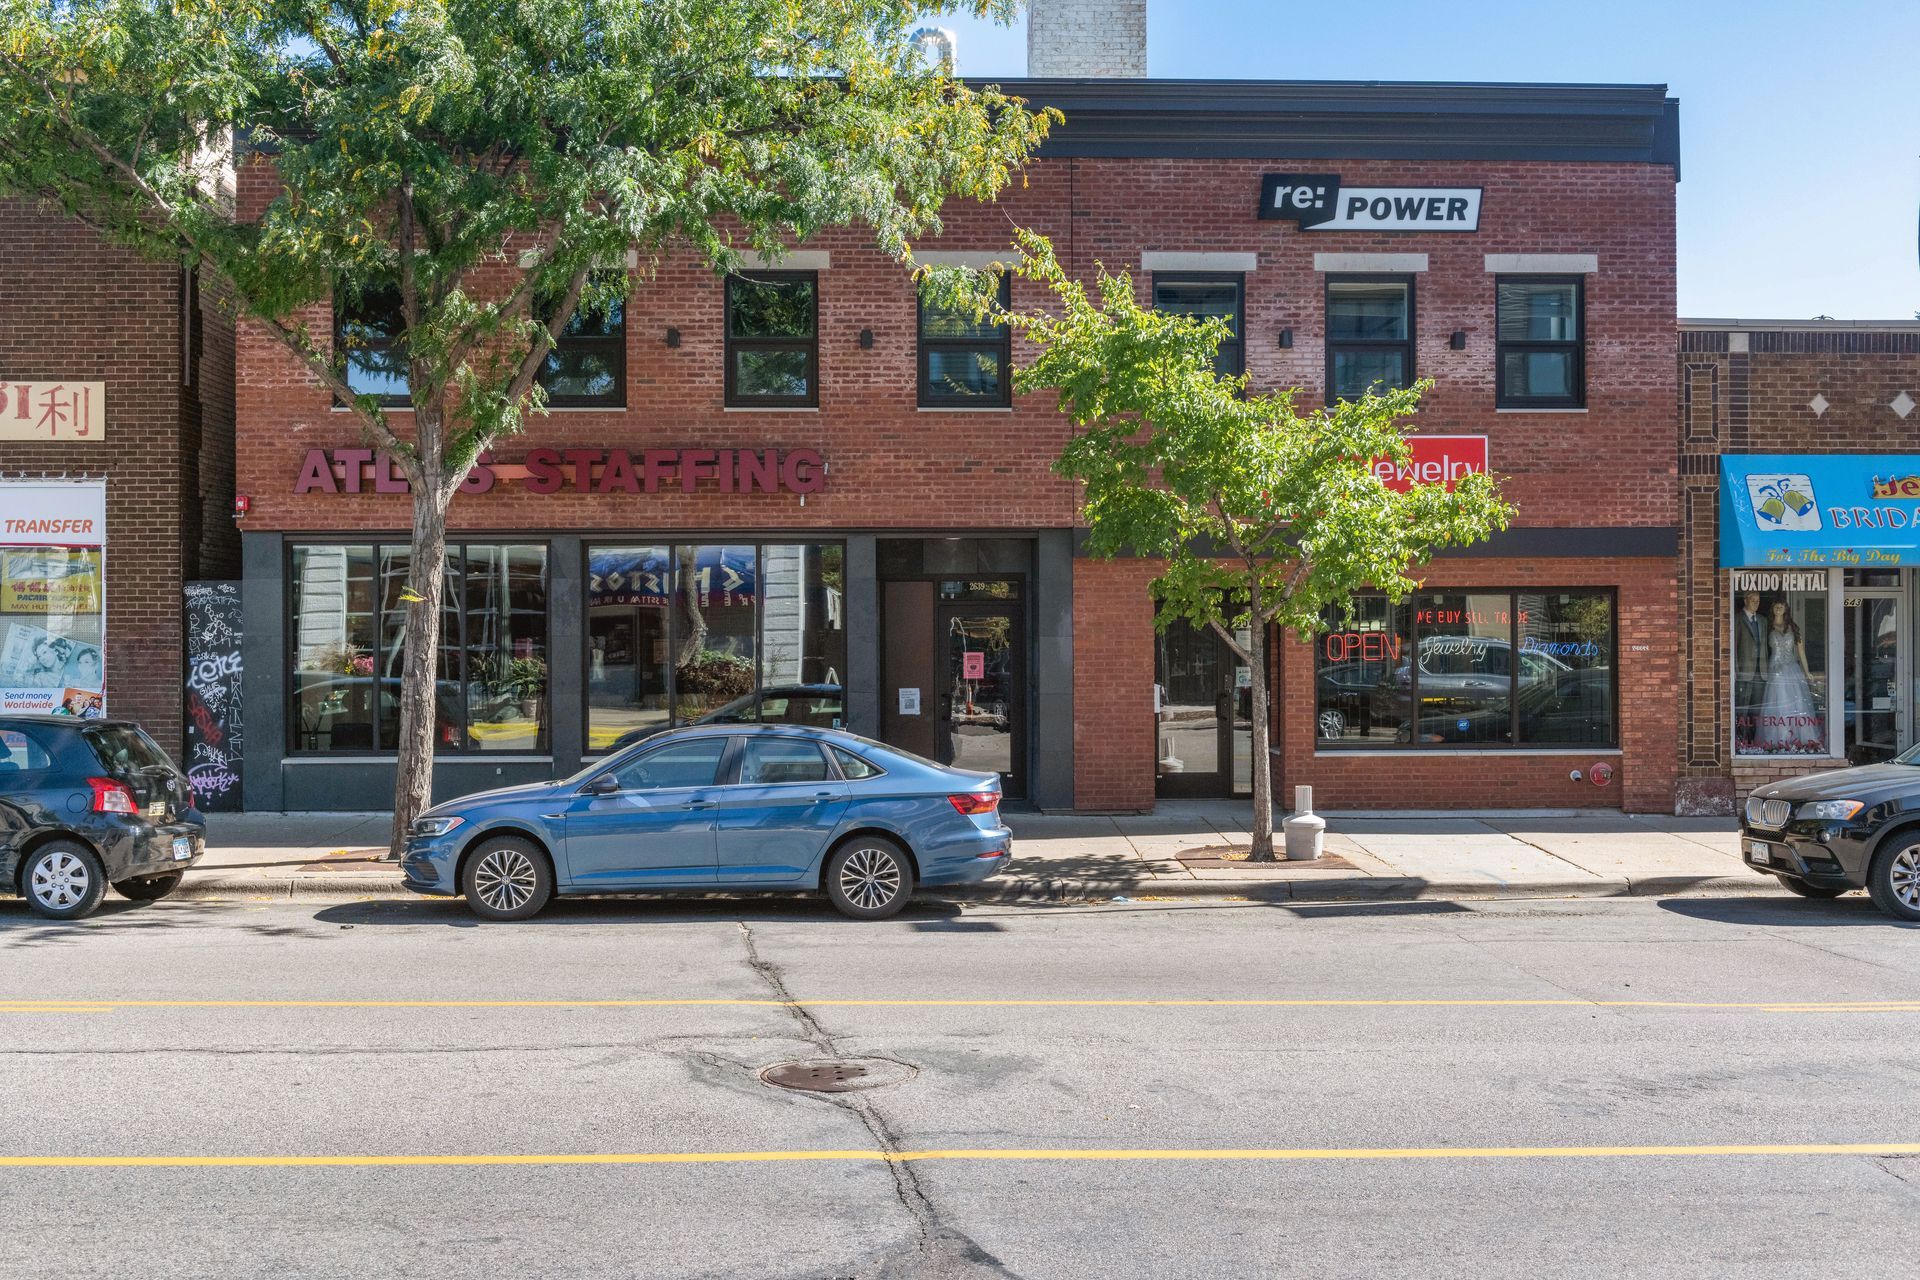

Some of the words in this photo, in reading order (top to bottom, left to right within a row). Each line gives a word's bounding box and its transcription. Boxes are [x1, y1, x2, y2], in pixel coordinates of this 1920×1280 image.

[1274, 186, 1325, 208] re:
[1346, 197, 1469, 221] POWER
[36, 385, 90, 436] 利
[293, 449, 495, 494] ATLS
[525, 448, 825, 494] STAFFING
[1371, 455, 1480, 481] ewelry
[5, 519, 93, 533] TRANSFER
[1767, 549, 1793, 563] For
[1797, 549, 1827, 563] The
[1831, 549, 1860, 565] Big
[1865, 549, 1901, 565] Day
[1734, 574, 1779, 592] TUXIDO
[1782, 574, 1827, 592] RENTAL
[1438, 610, 1461, 624] BUY
[1495, 610, 1530, 624] TRDE
[1327, 633, 1399, 662] OPEN
[1420, 636, 1489, 665] Jewelry
[1521, 637, 1599, 656] Diamonds
[5, 692, 25, 700] Send
[26, 692, 53, 701] money
[5, 700, 54, 709] Worldwide
